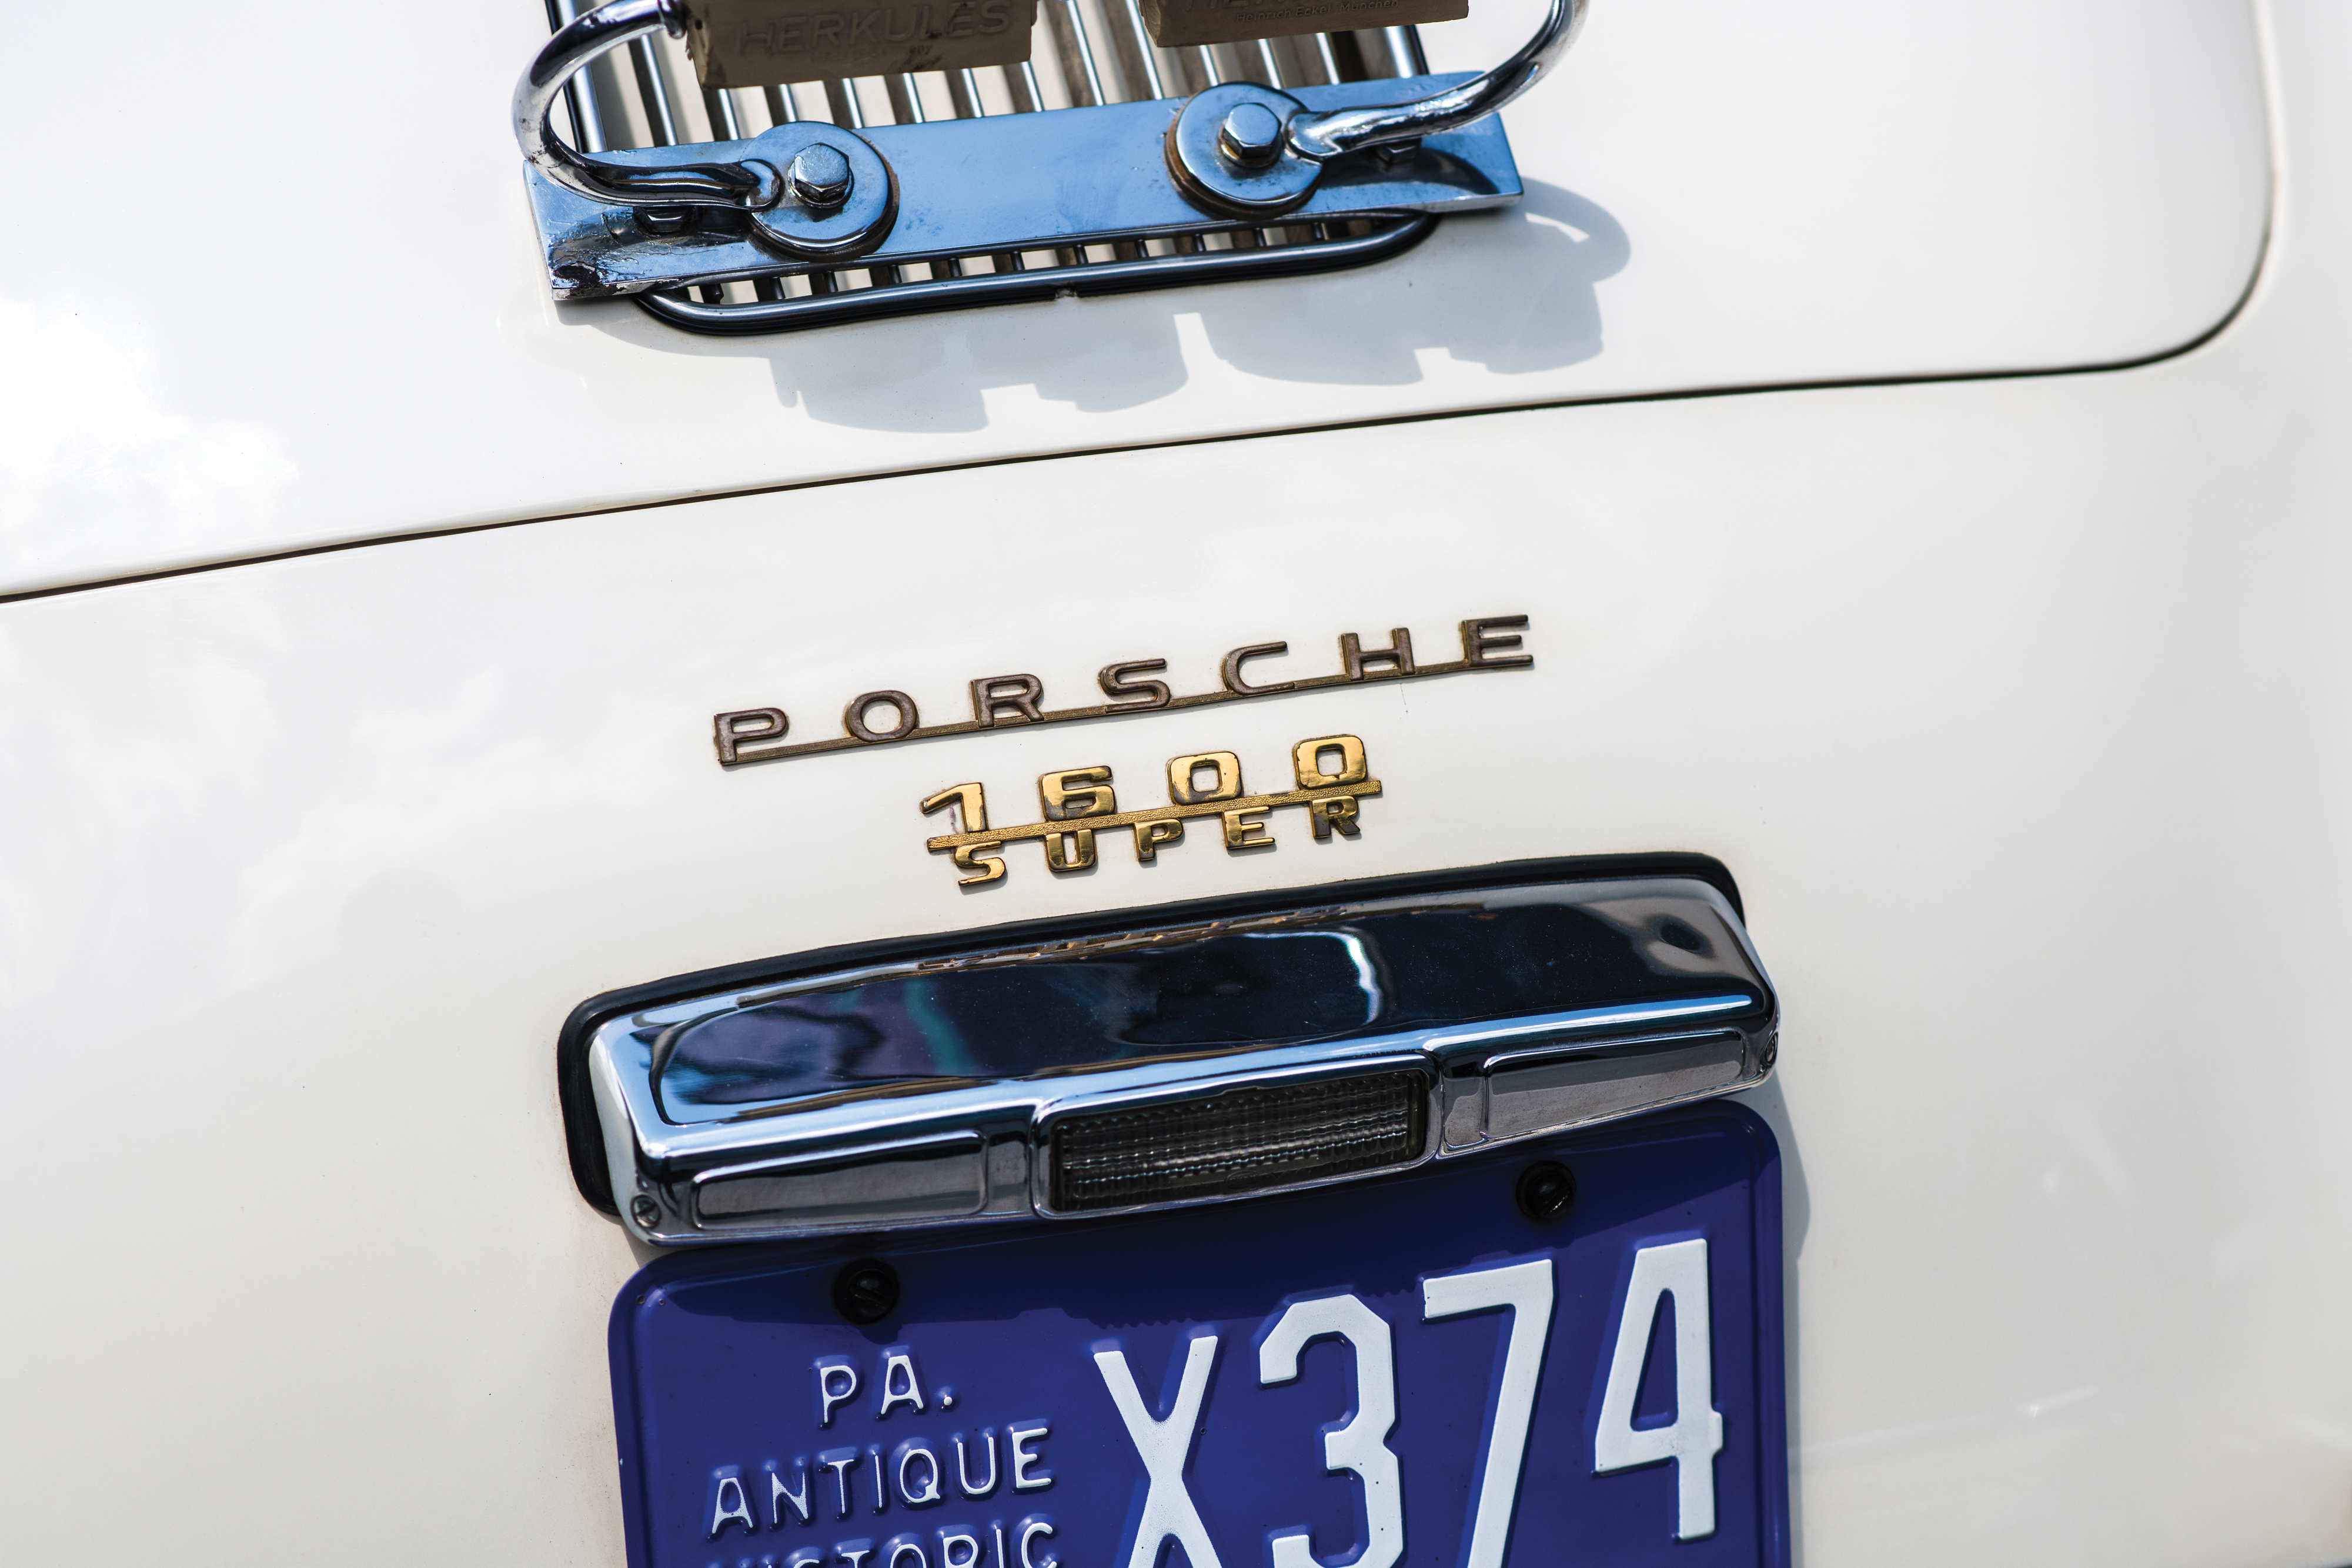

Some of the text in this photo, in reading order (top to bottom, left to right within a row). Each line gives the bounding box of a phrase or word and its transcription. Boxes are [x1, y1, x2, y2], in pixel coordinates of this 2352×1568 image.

[738, 0, 1011, 55] HERKULES
[1236, 8, 1291, 22] Heinrich
[1295, 4, 1331, 16] Eckel
[714, 614, 1534, 765] PORSCHE
[921, 734, 1368, 833] 1600
[954, 795, 1361, 886] SUPER
[819, 1354, 953, 1423] PA.
[1093, 1238, 1723, 1568] X374
[711, 1427, 1052, 1534] ANTIQUE
